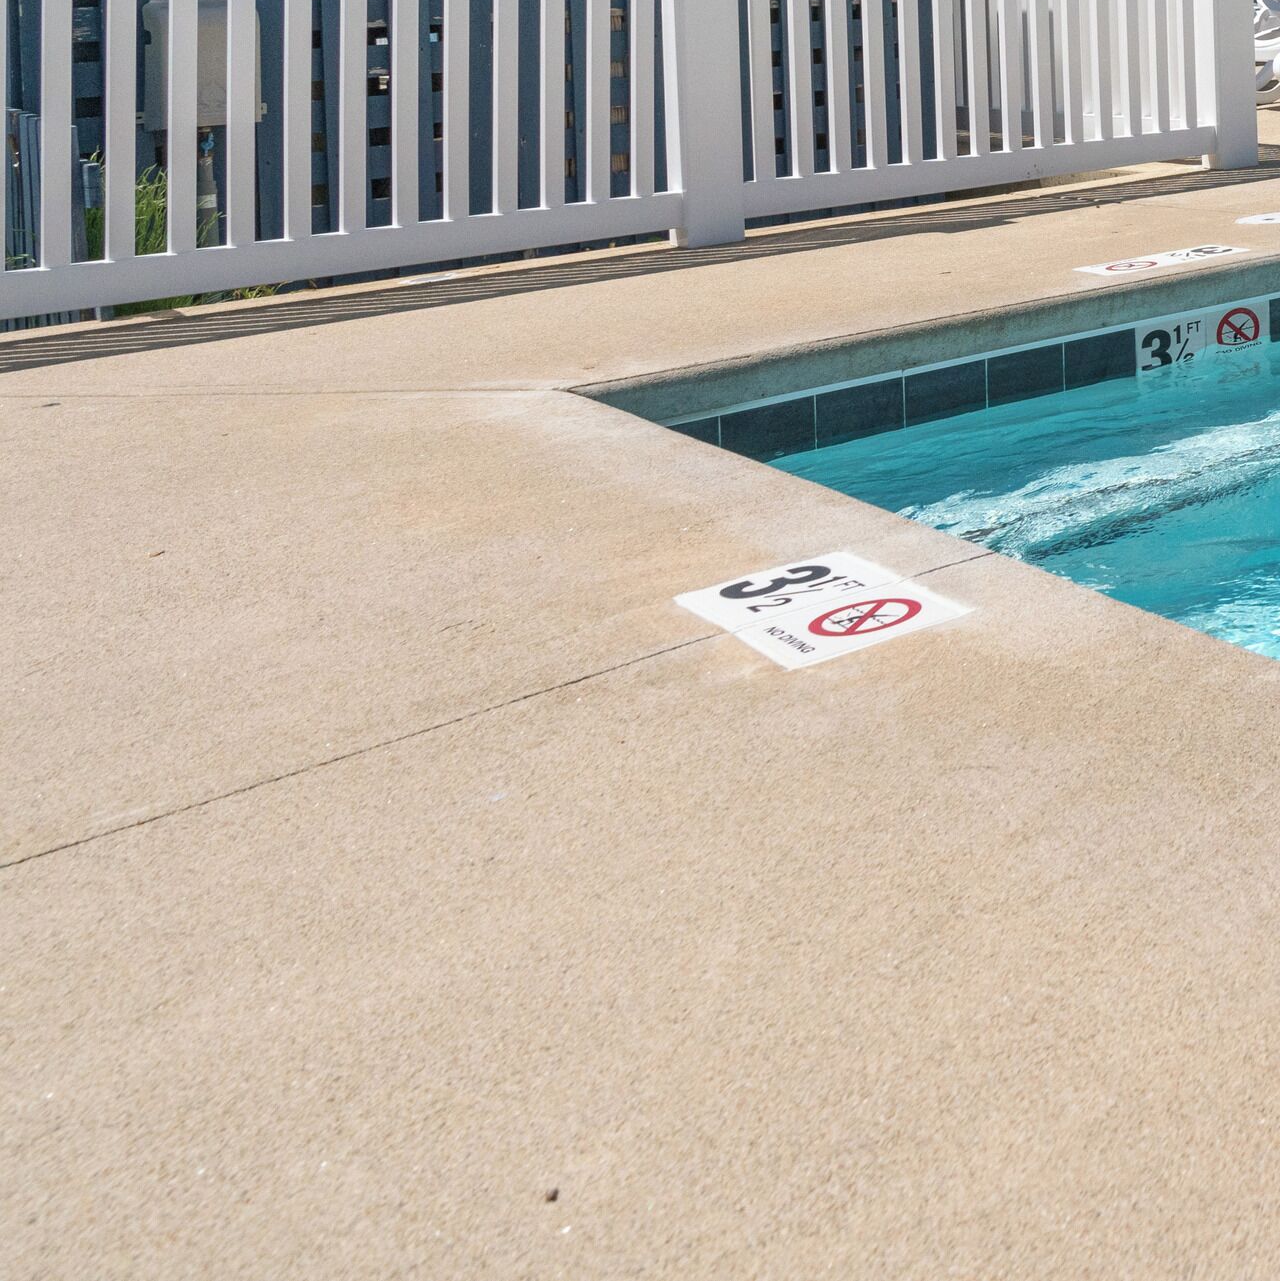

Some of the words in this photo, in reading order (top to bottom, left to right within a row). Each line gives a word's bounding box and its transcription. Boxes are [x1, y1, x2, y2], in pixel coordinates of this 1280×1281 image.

[1187, 320, 1202, 334] FT
[833, 579, 866, 592] FT
[763, 626, 781, 638] NO
[777, 634, 816, 654] DIVING
